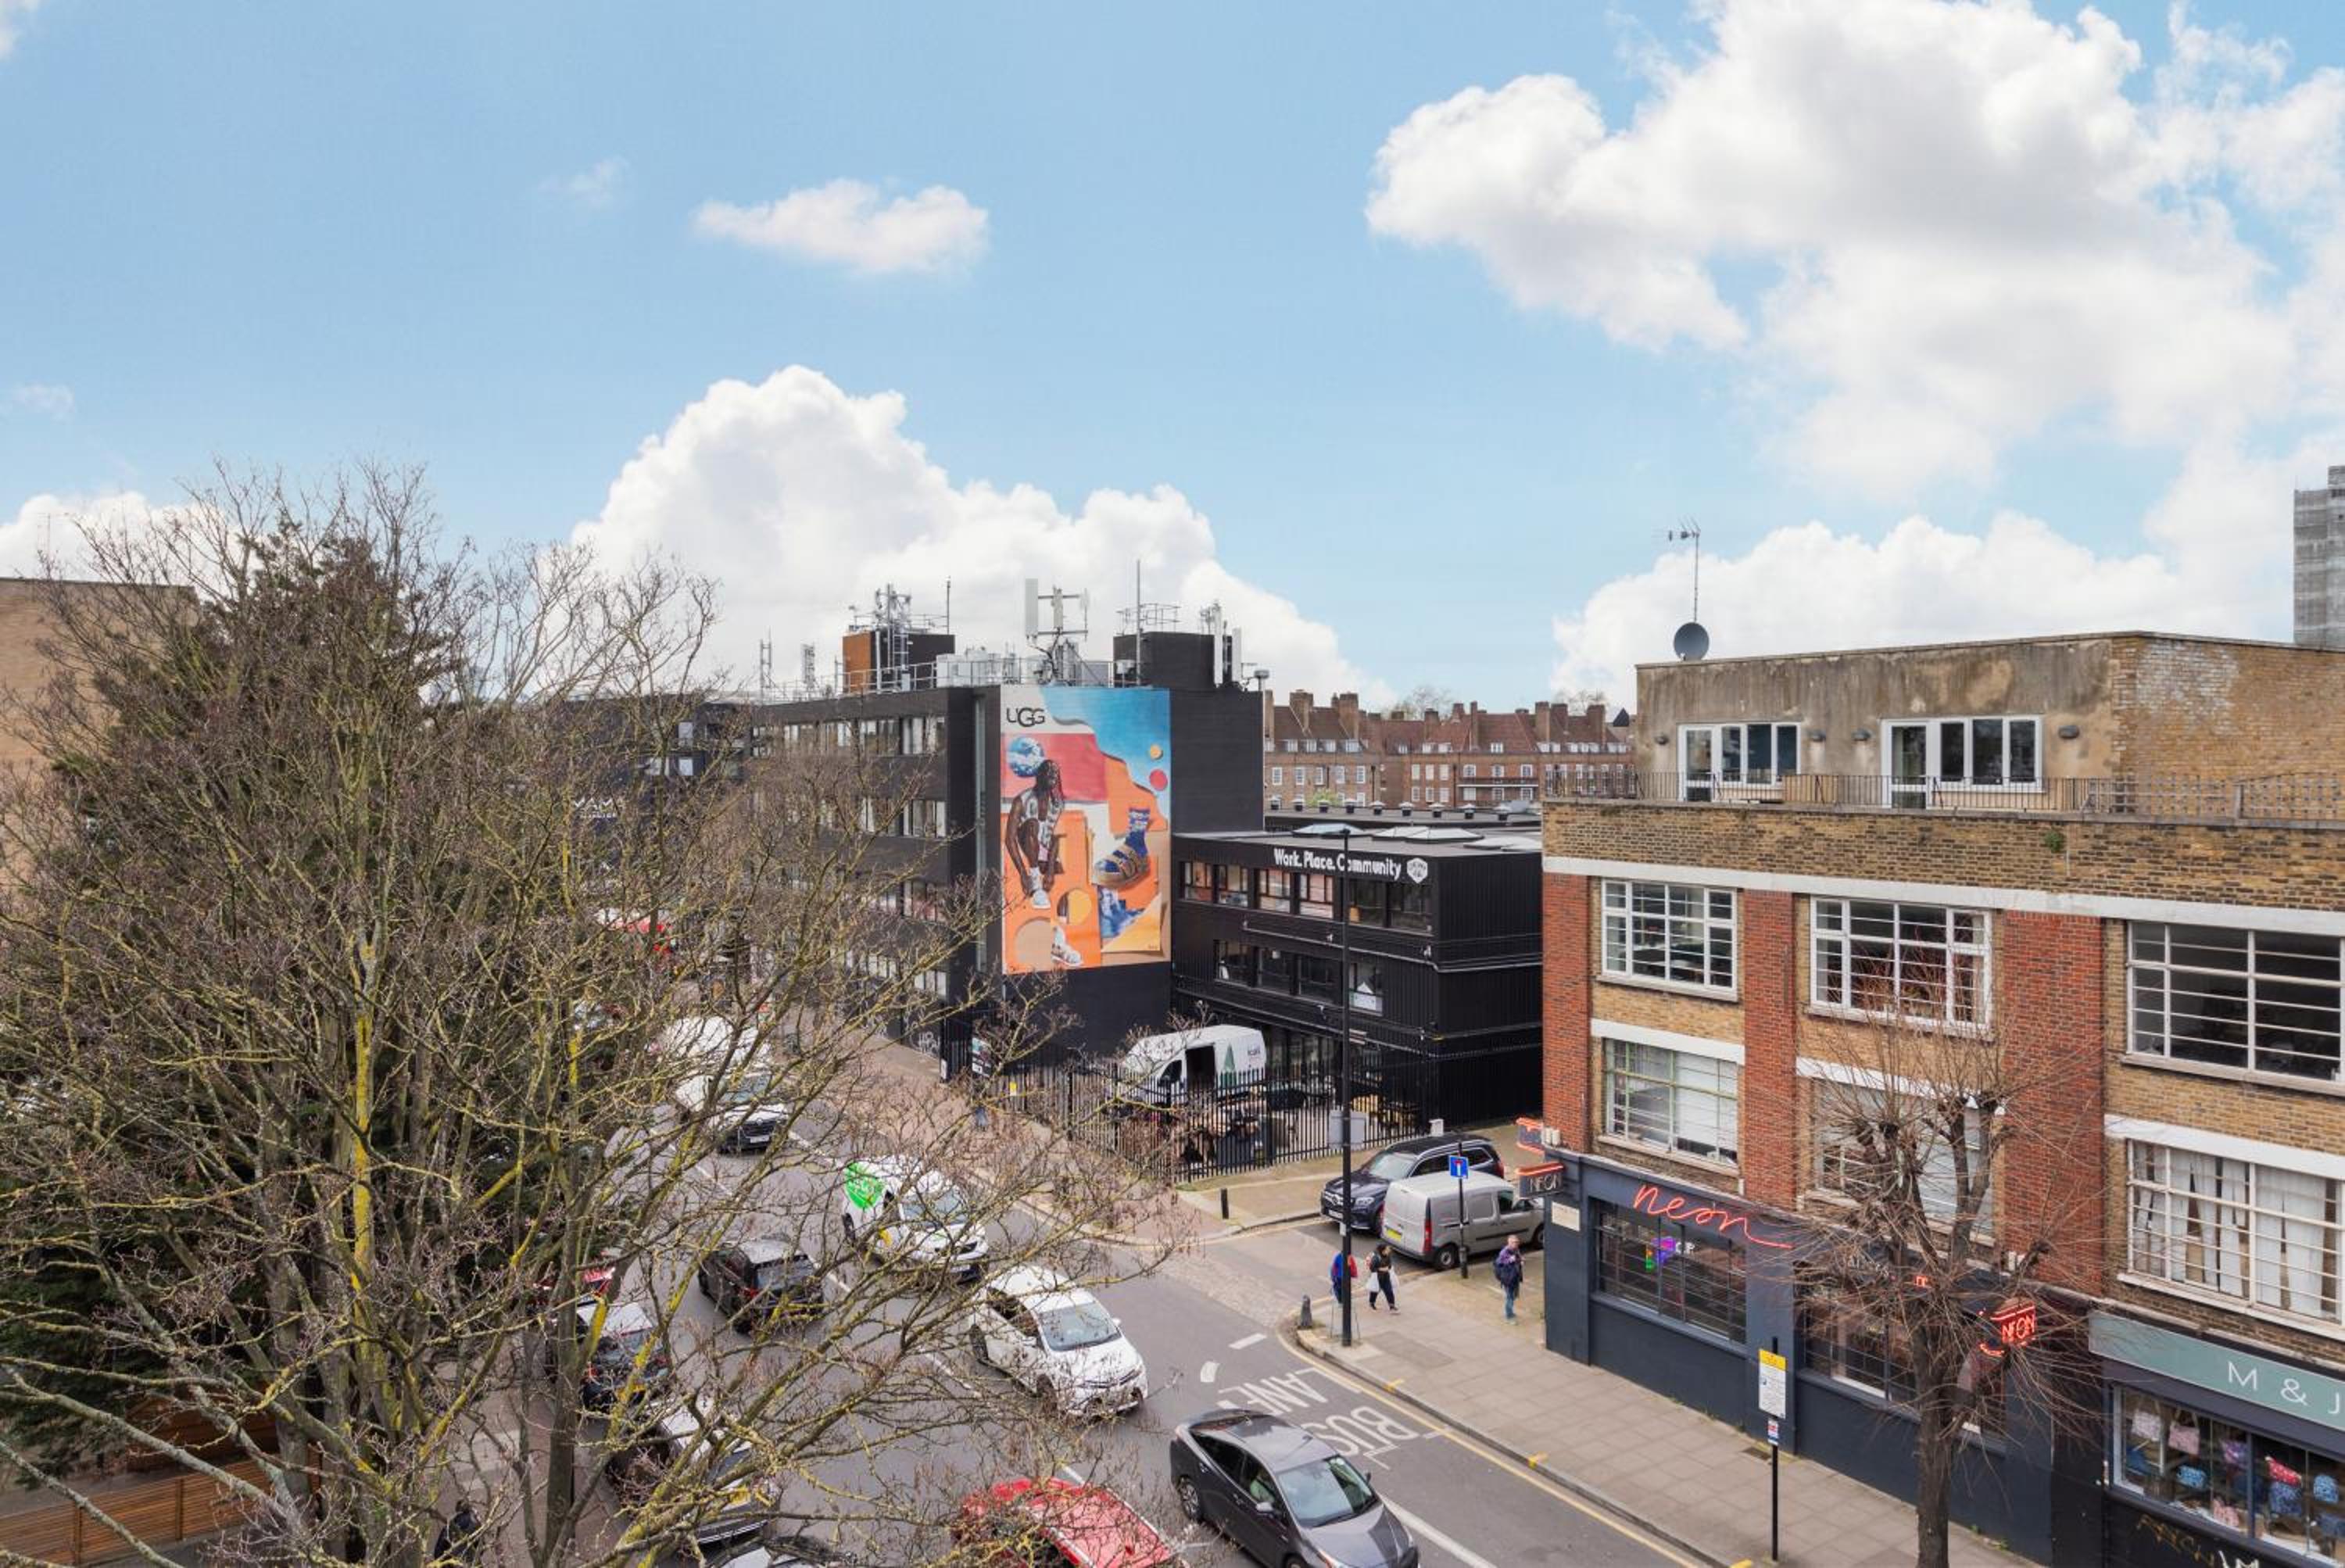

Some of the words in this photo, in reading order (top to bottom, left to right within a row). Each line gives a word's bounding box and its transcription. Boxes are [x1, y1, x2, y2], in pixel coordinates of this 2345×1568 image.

[1006, 707, 1045, 727] UGG
[1273, 848, 1302, 867] Work.
[1303, 850, 1336, 870] Place.
[1632, 1183, 1795, 1249] neon
[2002, 1315, 2035, 1343] NEON
[1218, 1367, 1362, 1416] LANE
[2228, 1361, 2257, 1391] M
[2280, 1378, 2309, 1405] &
[2327, 1392, 2340, 1414] J
[1300, 1406, 1420, 1456] BUS
